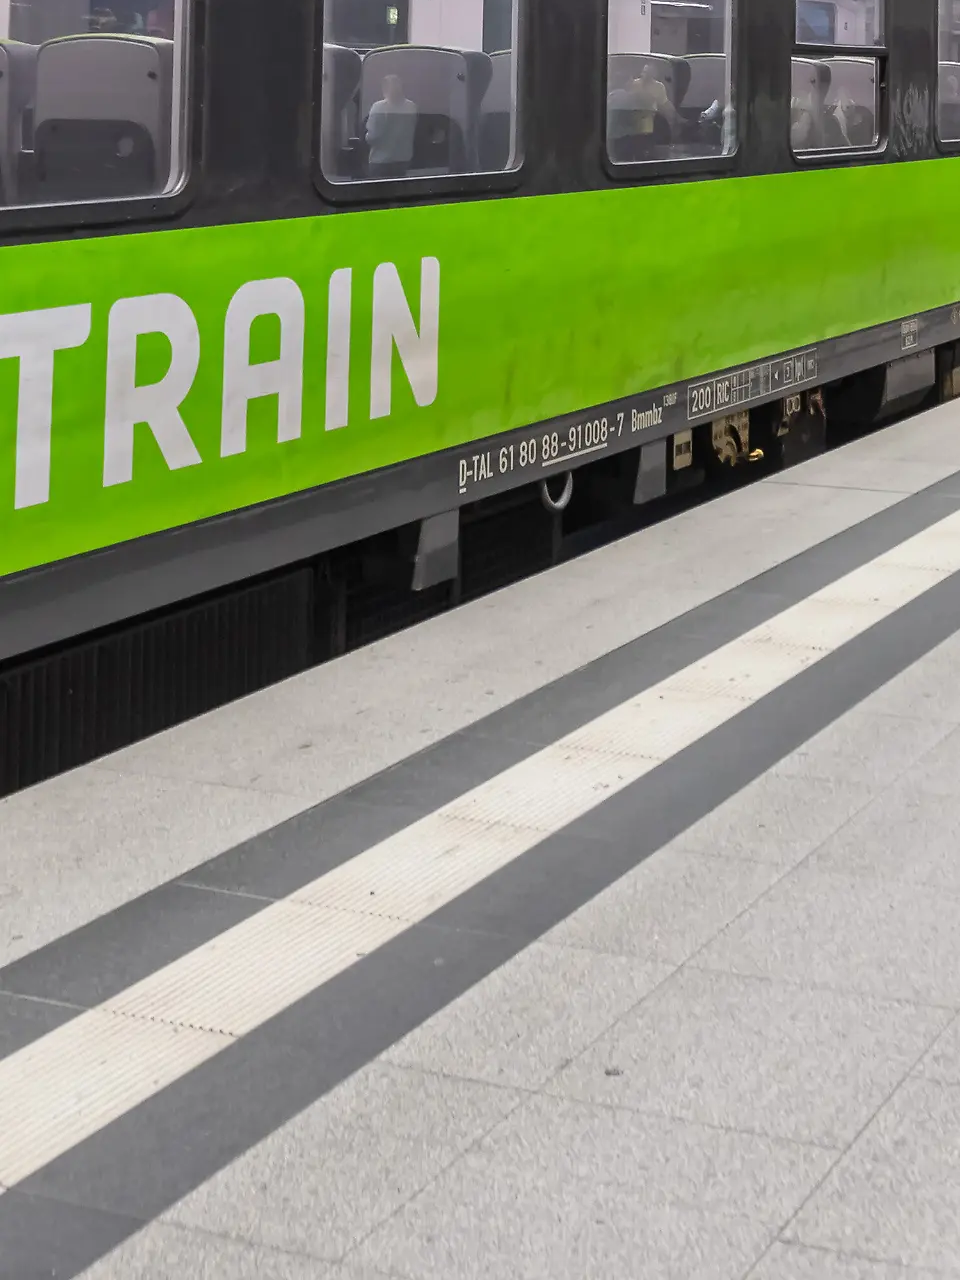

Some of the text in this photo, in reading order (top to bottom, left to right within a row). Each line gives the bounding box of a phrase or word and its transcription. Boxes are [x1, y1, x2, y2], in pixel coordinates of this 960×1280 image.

[0, 256, 441, 510] TRAIN
[692, 386, 711, 413] 200
[716, 381, 730, 405] RIC
[459, 452, 493, 490] D-TAL
[499, 445, 514, 474] 61
[519, 439, 537, 467] 80
[631, 403, 663, 433] Bmmbz
